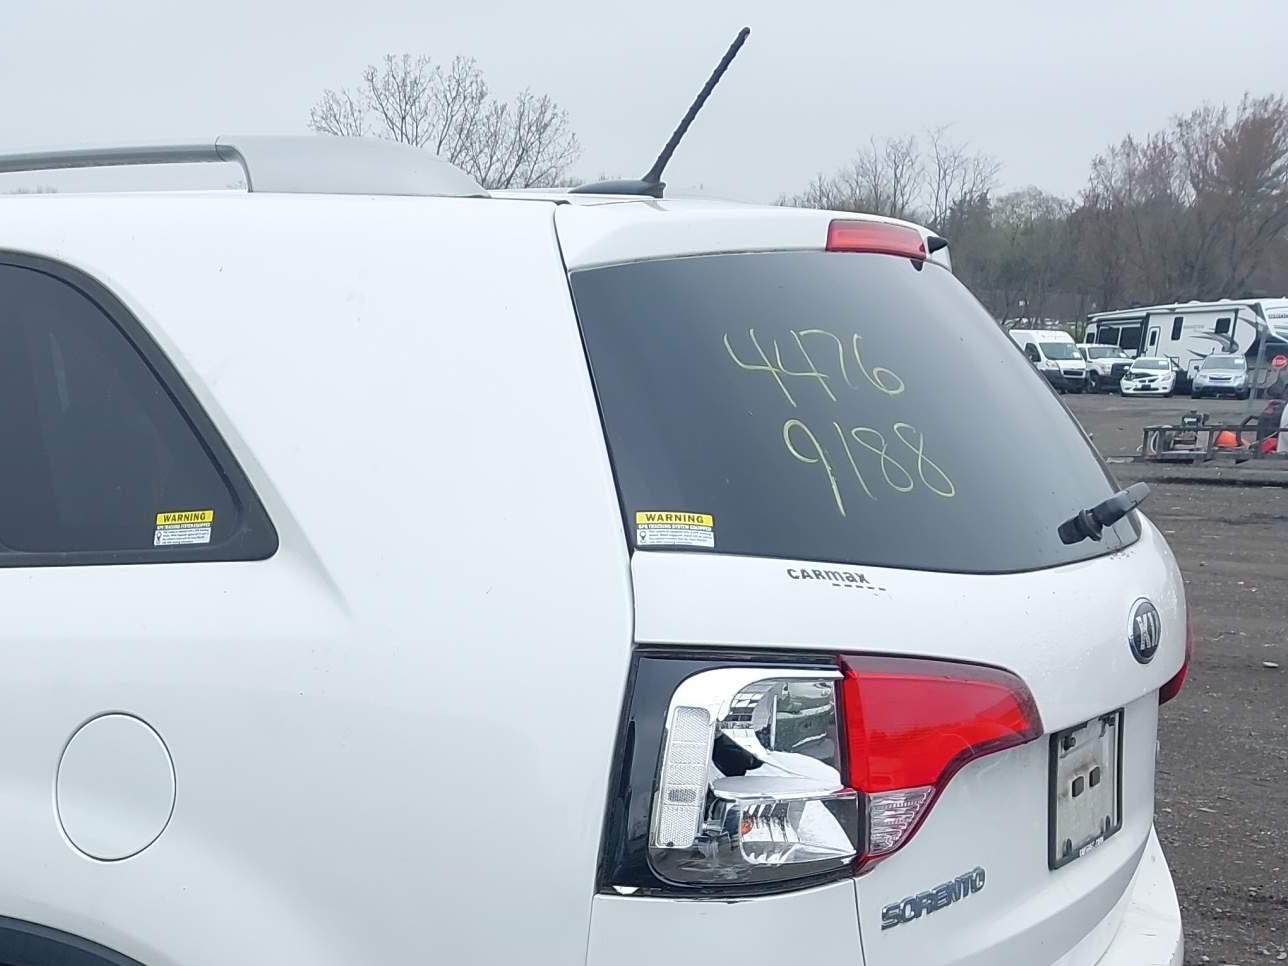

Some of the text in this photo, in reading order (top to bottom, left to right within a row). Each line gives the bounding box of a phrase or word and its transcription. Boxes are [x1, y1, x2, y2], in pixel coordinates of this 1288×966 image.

[723, 328, 905, 407] 4476
[783, 419, 956, 518] 9188
[163, 512, 206, 523] WARNING
[645, 513, 704, 524] WARNING
[880, 866, 986, 931] SORENTO
